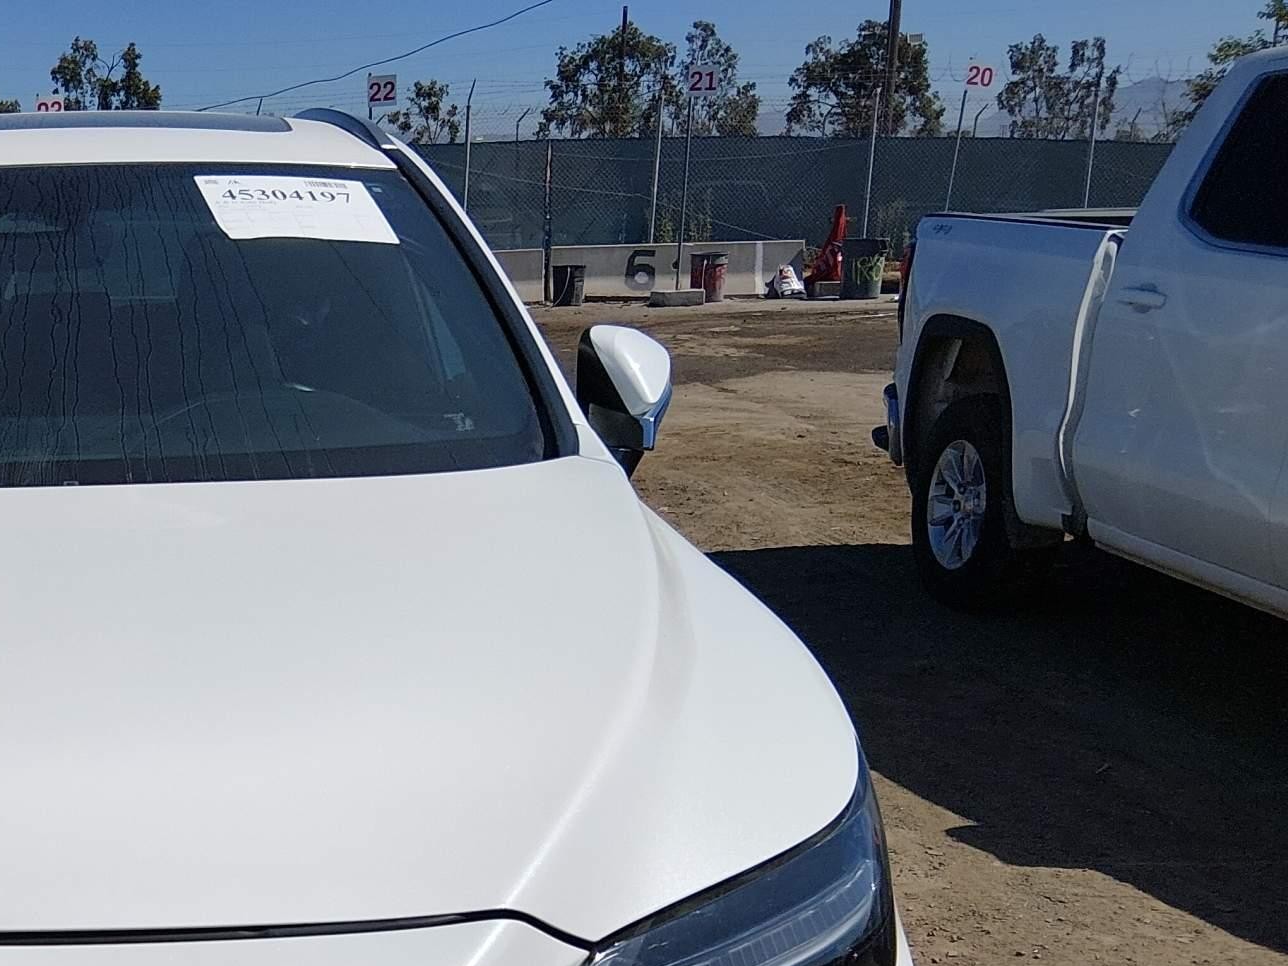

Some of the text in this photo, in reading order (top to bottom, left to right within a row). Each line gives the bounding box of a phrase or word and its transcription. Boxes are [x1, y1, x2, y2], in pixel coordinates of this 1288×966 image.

[689, 71, 717, 91] 21
[967, 66, 993, 87] 20
[369, 81, 396, 102] 22
[222, 189, 350, 203] 45304197
[624, 249, 657, 291] 6
